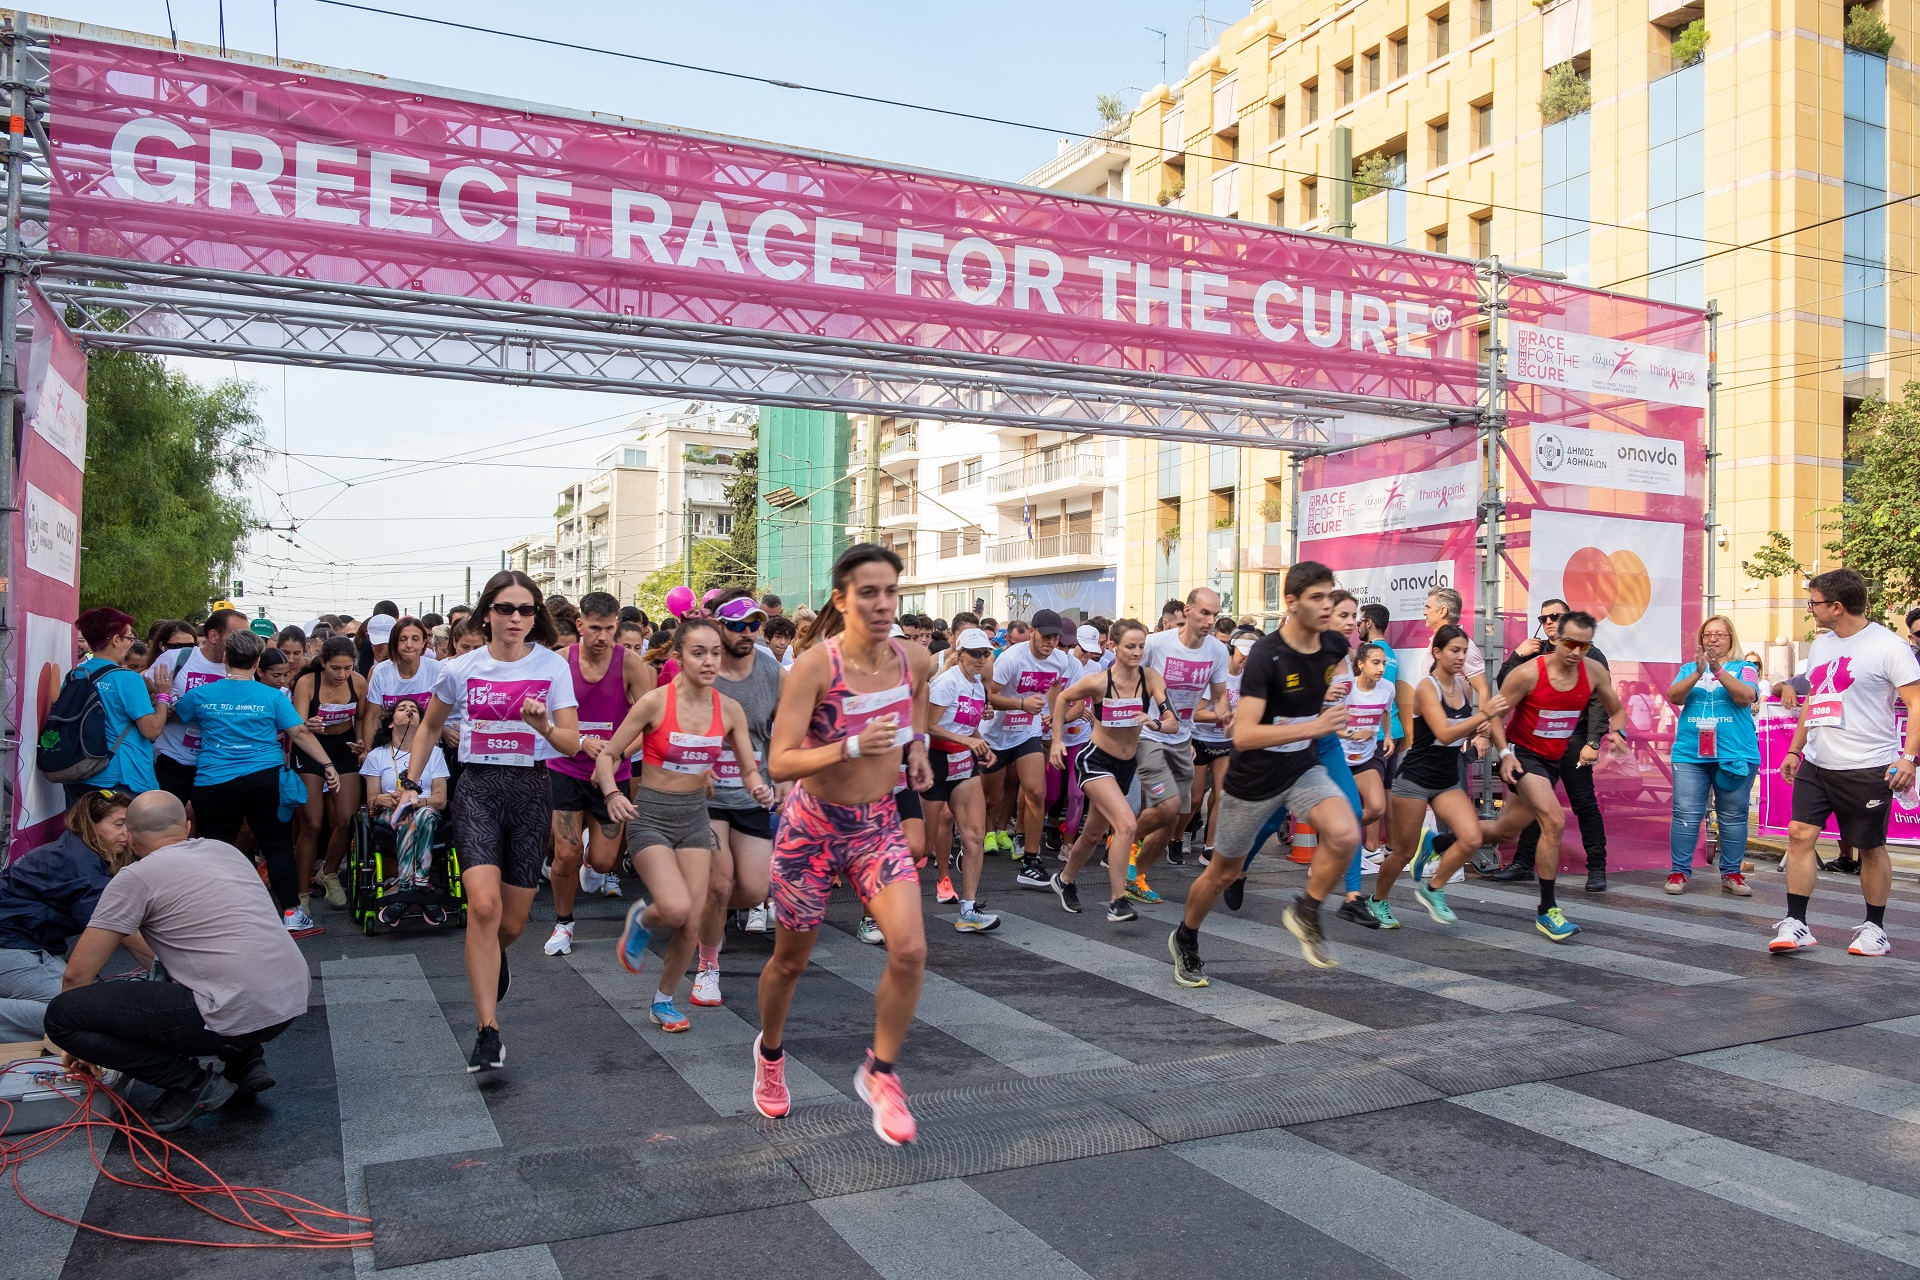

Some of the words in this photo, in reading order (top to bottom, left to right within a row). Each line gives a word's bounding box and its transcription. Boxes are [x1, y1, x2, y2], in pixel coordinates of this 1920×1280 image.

[110, 117, 577, 253] GREECE
[611, 189, 865, 290] RACE
[895, 226, 1064, 314] FOR
[1089, 257, 1232, 335] THE
[1528, 331, 1565, 350] RACE
[1527, 347, 1555, 364] FOR
[1556, 352, 1580, 368] THE
[1527, 363, 1565, 382] CURE
[1650, 364, 1671, 377] think
[1677, 368, 1695, 382] pink
[1566, 446, 1594, 457] ΔΗΜΟΣ
[1566, 458, 1607, 470] ΑΘΗΝΑΙΩΝ
[1315, 491, 1346, 507] RACE
[1419, 487, 1441, 500] think
[1447, 481, 1465, 499] pink
[1314, 506, 1334, 521] FOR
[1337, 503, 1356, 517] THE
[1314, 520, 1343, 535] CURE
[1168, 659, 1185, 667] RACE
[469, 686, 488, 705] 15
[487, 738, 519, 749] 5329
[681, 750, 709, 761] 1636
[720, 765, 741, 775] 829
